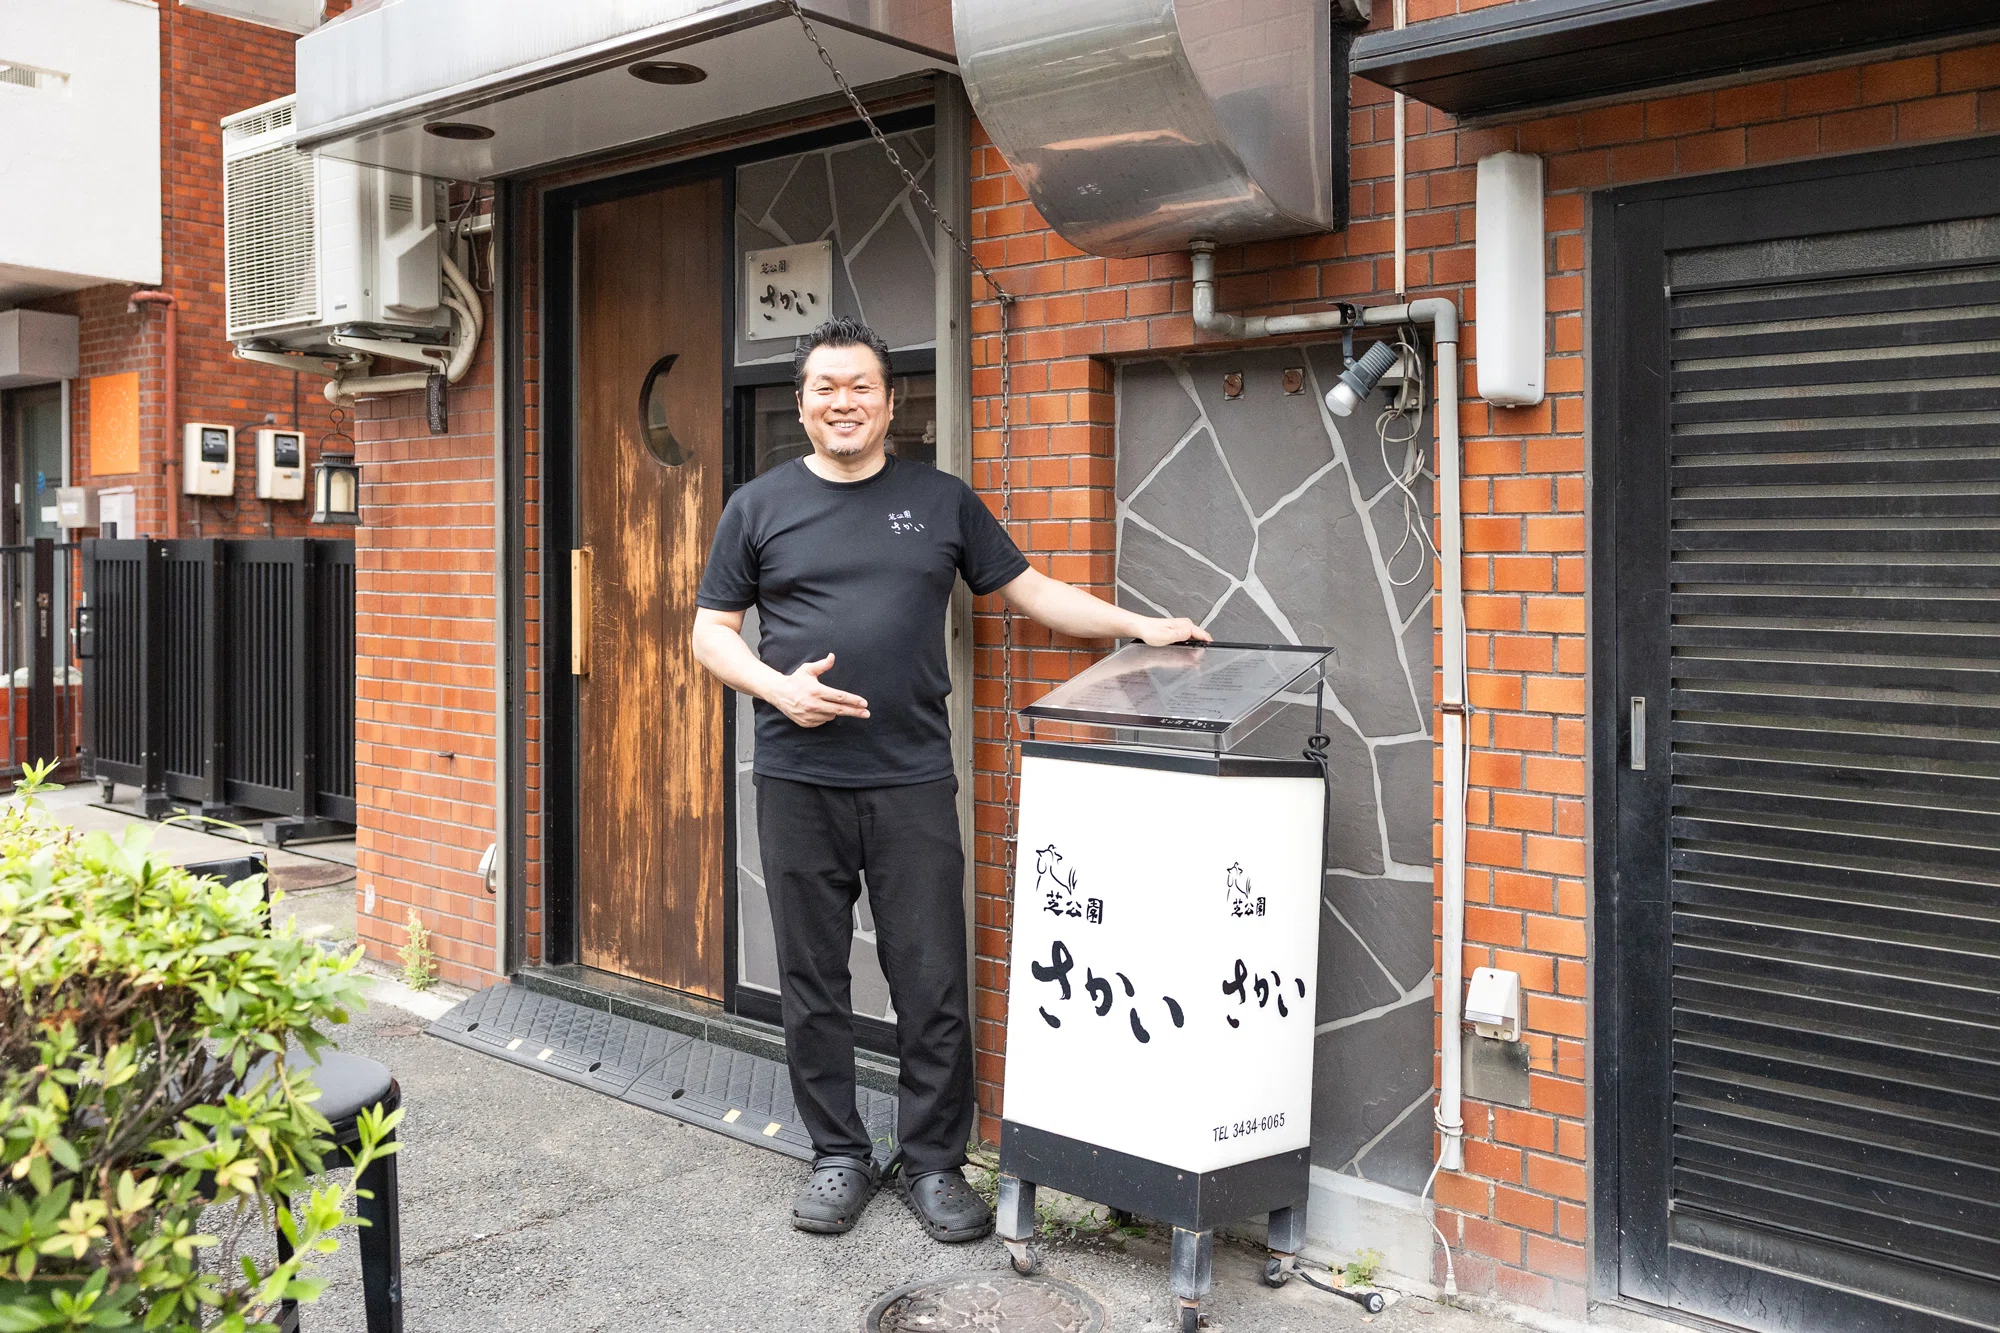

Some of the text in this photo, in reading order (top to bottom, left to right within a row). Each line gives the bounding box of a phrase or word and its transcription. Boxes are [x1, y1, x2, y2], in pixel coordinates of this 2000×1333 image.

[760, 260, 786, 275] 芝公園
[760, 285, 815, 320] さかい
[891, 522, 925, 534] さかい
[1043, 890, 1103, 924] 芝公園
[1231, 897, 1266, 917] 芝公園
[1032, 941, 1184, 1043] さかい
[1223, 959, 1306, 1028] さかい
[1213, 1112, 1285, 1142] TEL 3434-6065
